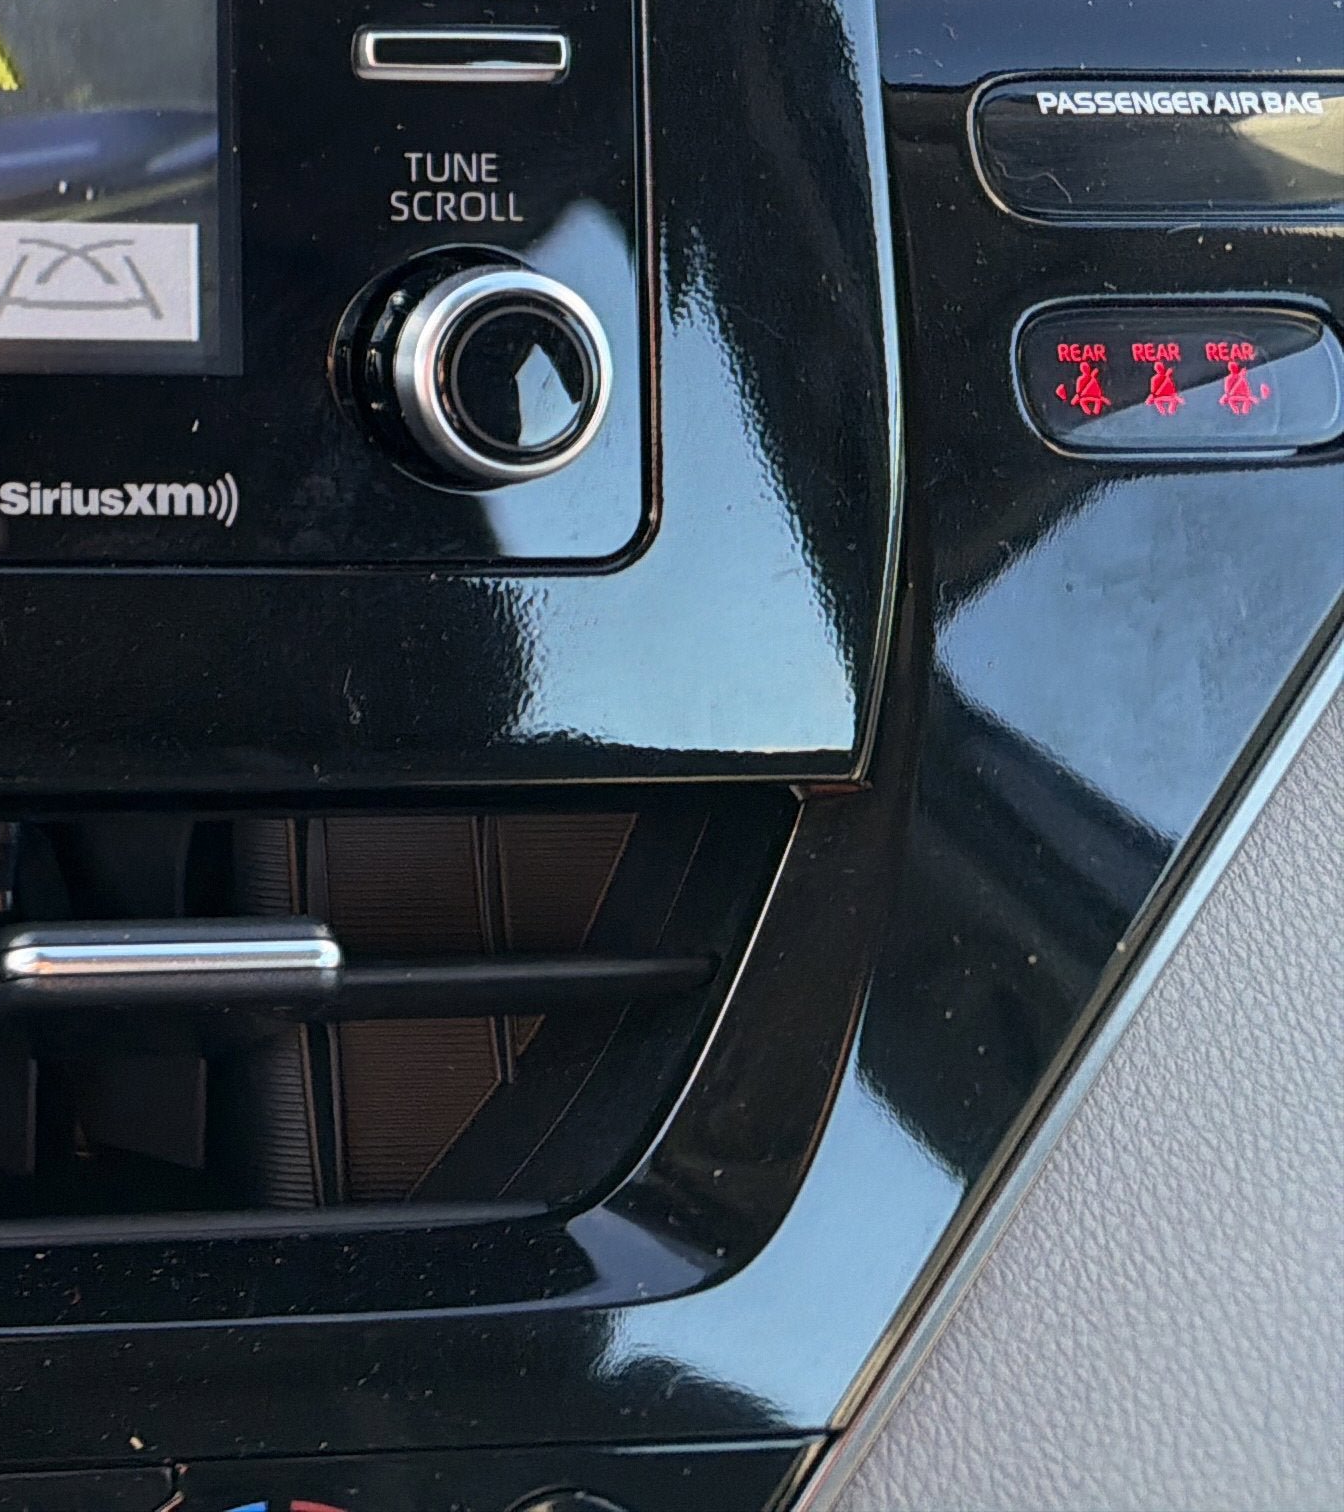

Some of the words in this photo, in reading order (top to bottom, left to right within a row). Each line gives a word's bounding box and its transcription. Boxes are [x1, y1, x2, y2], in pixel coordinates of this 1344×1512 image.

[1037, 91, 1211, 115] PASSENGER
[1213, 91, 1262, 115] AIR
[1262, 91, 1323, 115] BAG
[404, 152, 499, 183] TUNE
[389, 191, 524, 222] SCROLL
[1057, 344, 1107, 362] REAR
[1132, 343, 1180, 362] REAR
[1205, 343, 1255, 362] REAR
